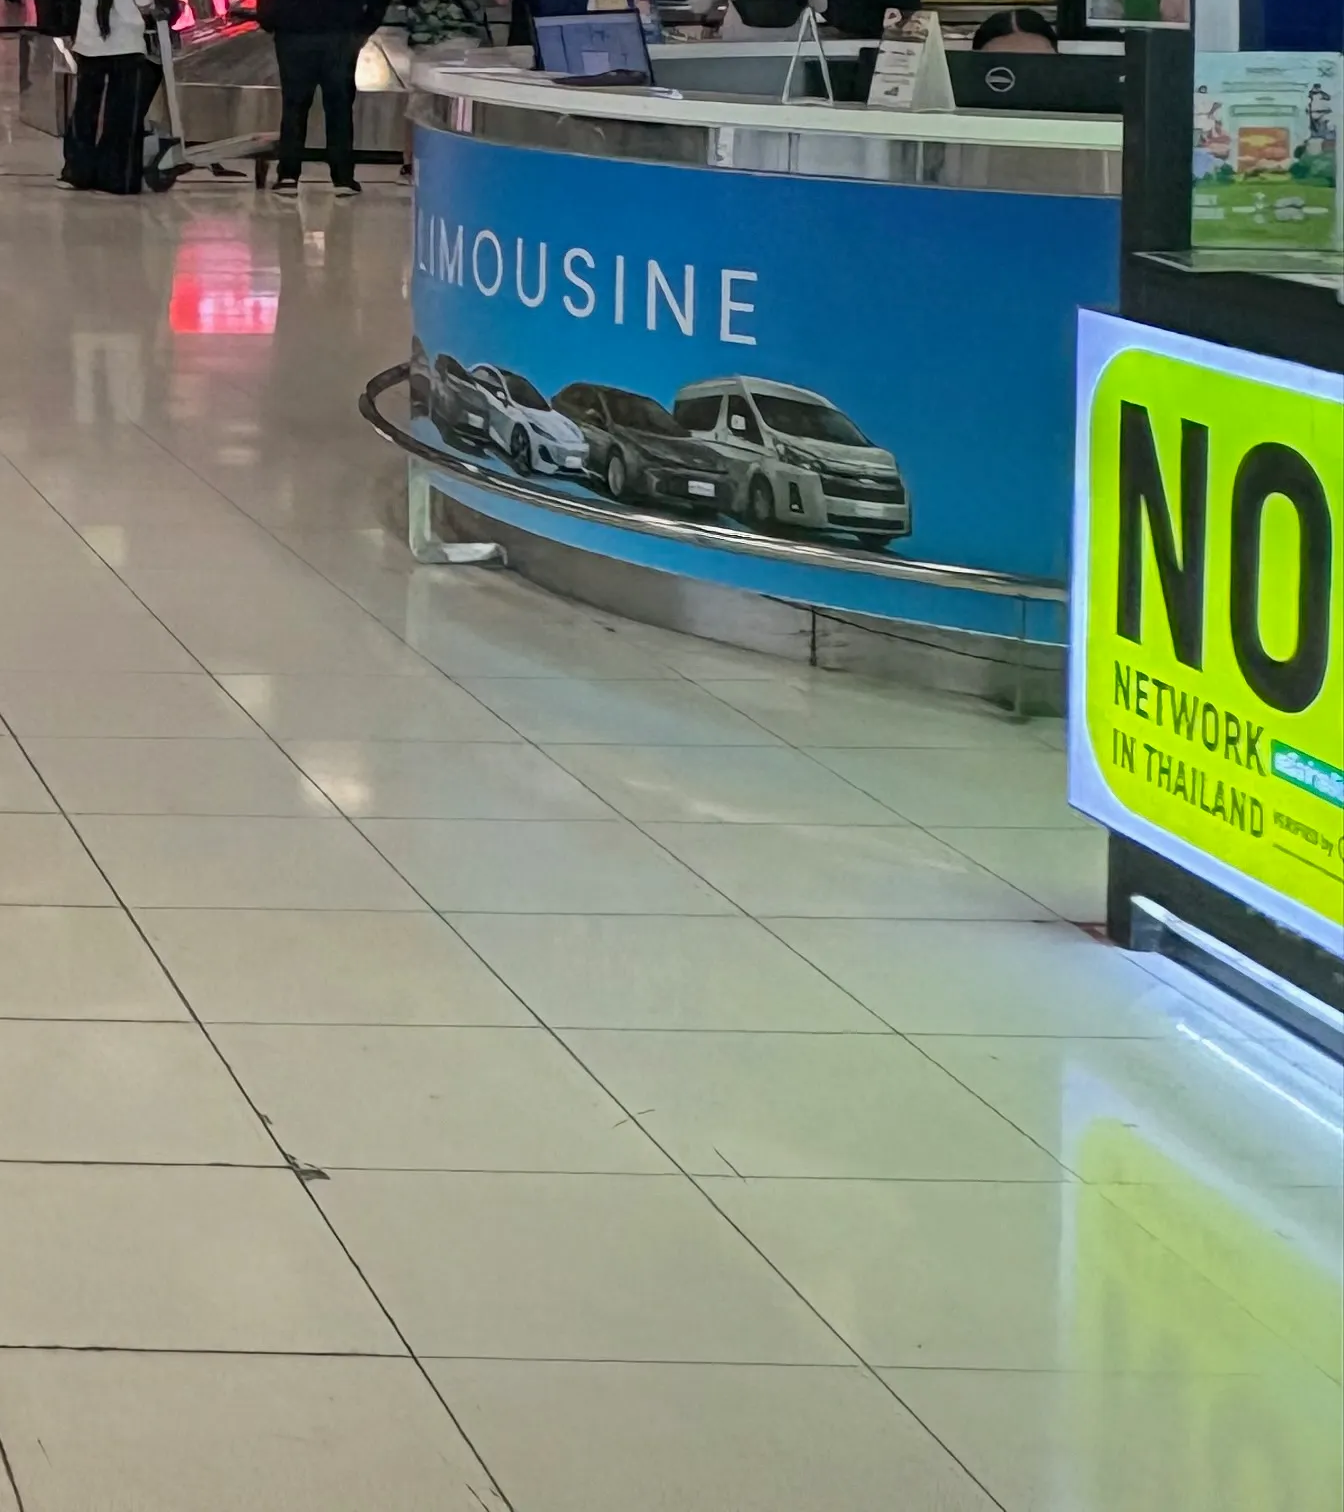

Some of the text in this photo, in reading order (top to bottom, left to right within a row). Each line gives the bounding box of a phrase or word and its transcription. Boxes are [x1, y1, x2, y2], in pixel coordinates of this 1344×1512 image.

[418, 208, 758, 346] LIMOUSINE
[1114, 398, 1332, 714] NO
[1113, 659, 1268, 778] NETWORK
[1113, 728, 1136, 775] IN
[1143, 742, 1265, 840] THAILAND
